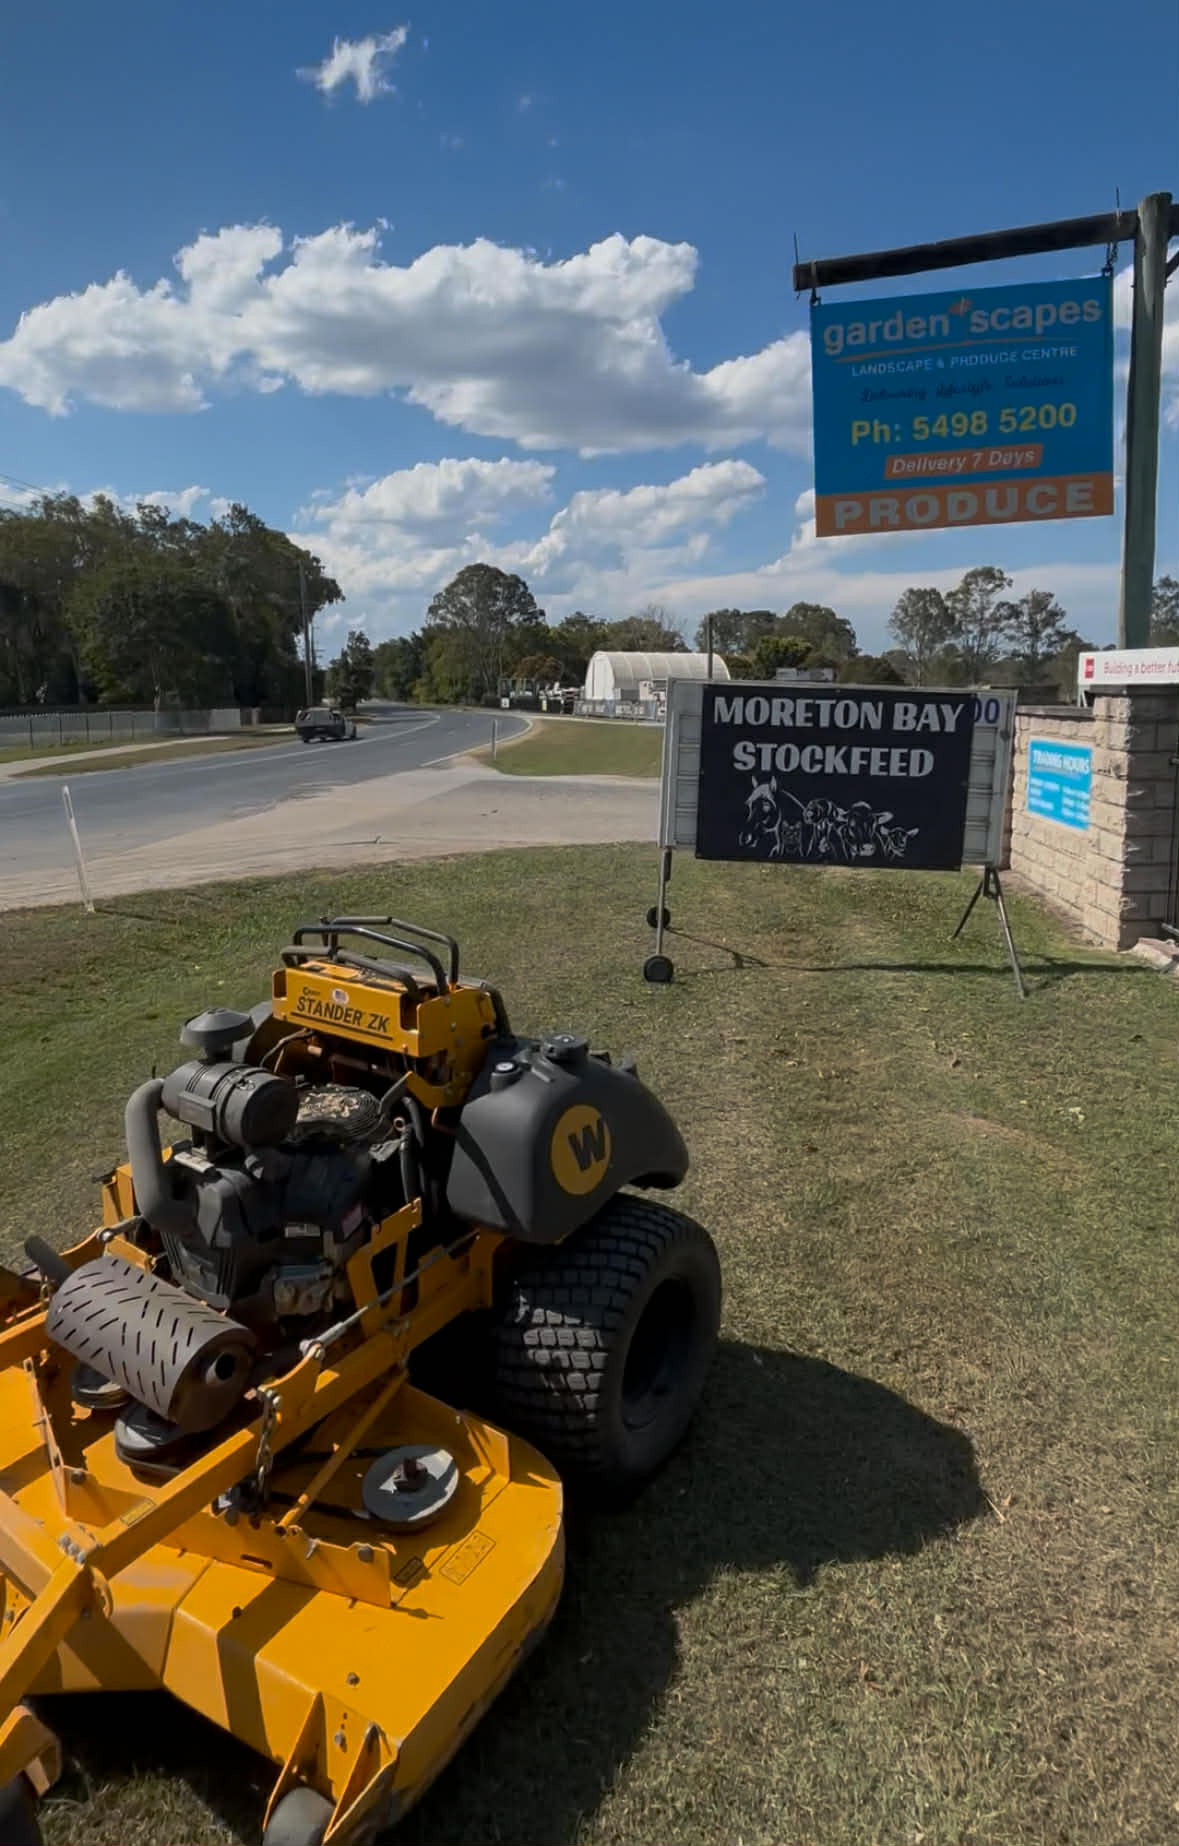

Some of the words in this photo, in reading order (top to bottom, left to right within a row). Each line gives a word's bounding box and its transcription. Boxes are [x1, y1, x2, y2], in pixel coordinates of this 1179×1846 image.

[823, 311, 949, 356] garden
[969, 299, 1102, 335] scapes
[851, 357, 933, 377] LANDSCAPE
[951, 350, 1018, 368] PRODUCE
[1021, 345, 1079, 361] CENTRE
[851, 419, 901, 446] Ph:
[912, 411, 988, 441] 5498
[999, 403, 1077, 433] 5200
[892, 452, 966, 474] Delivery
[973, 452, 983, 466] 7
[988, 448, 1035, 467] Days
[834, 480, 1094, 529] PRODUCE
[713, 696, 884, 730] MORETON
[893, 702, 965, 732] BAY
[732, 741, 934, 778] STOCKFEED
[297, 996, 363, 1026] STANDER
[368, 1012, 391, 1033] ZK
[567, 1118, 606, 1173] W
